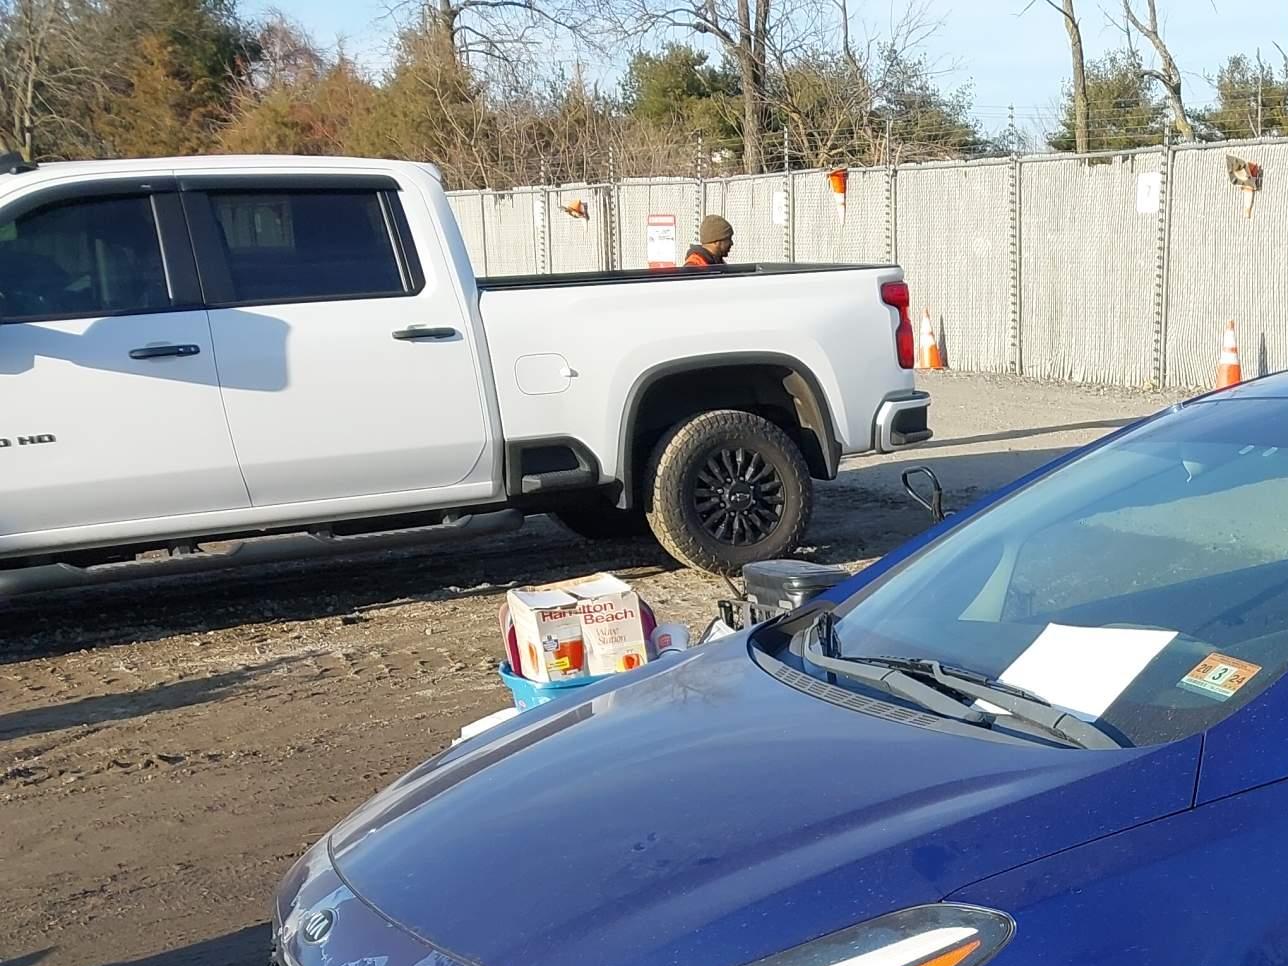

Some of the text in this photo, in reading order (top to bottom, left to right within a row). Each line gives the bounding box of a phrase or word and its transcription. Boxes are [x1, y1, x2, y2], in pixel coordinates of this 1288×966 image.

[17, 433, 57, 445] HD
[584, 609, 634, 625] Beach
[1212, 667, 1229, 681] 3
[1229, 674, 1246, 684] 24
